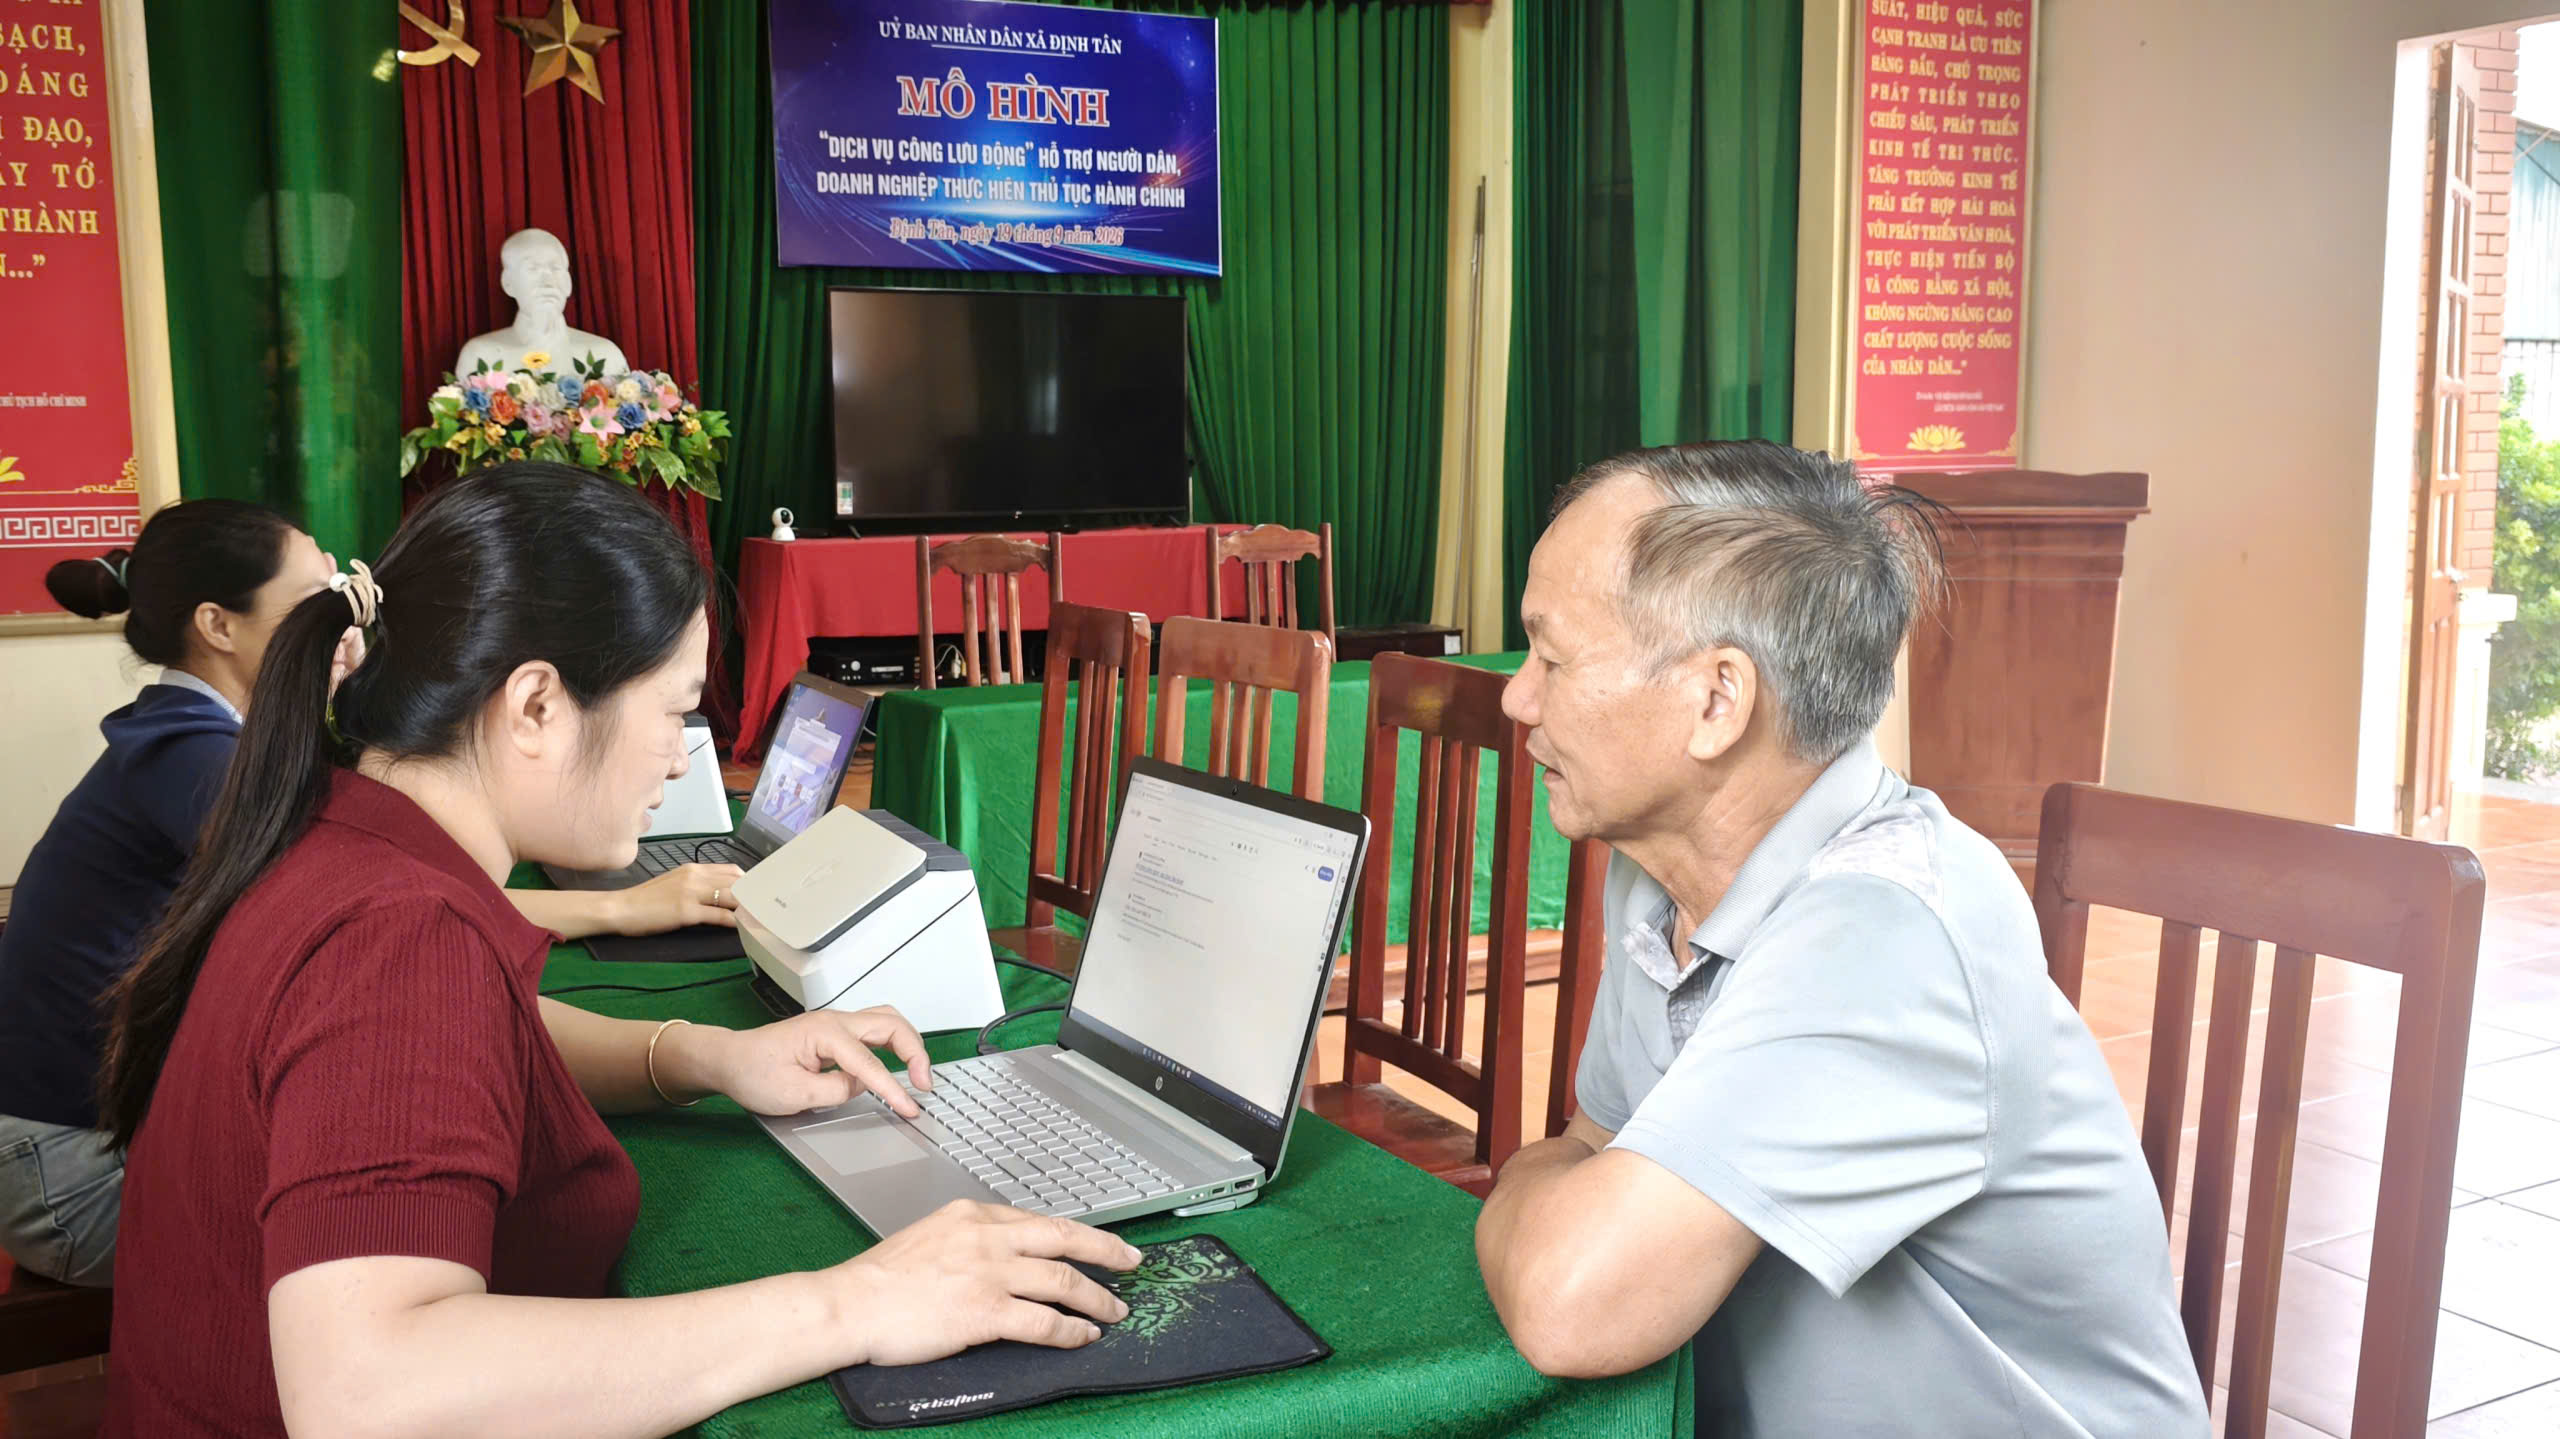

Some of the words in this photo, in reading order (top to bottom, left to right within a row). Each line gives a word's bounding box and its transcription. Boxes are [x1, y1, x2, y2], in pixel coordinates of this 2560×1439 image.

[1916, 2, 1949, 24] HIỆU
[1956, 4, 1988, 28] QUẢ,
[0, 22, 86, 56] ẠCH,
[879, 16, 901, 38] UỶ
[906, 23, 938, 41] BAN
[942, 23, 986, 45] NHÂN
[990, 26, 1022, 46] DÂN
[1026, 29, 1046, 49] XÃ
[1050, 35, 1089, 55] ĐỊNH
[1092, 34, 1122, 54] TÂN
[1872, 26, 1904, 48] CẠNH
[1906, 30, 1948, 50] TRANH
[1951, 32, 1966, 52] LÀ
[1970, 36, 1988, 53] ƯU
[1992, 35, 2022, 55] TIÊN
[1870, 52, 1904, 74] HÀNG
[1978, 64, 2022, 85] TRỌNG
[896, 66, 976, 119] MÔ
[986, 72, 1110, 127] HÌNH
[1870, 81, 1910, 102] PHÁT
[1918, 82, 1968, 106] TRIỂN
[1976, 92, 2021, 110] THEO
[22, 116, 93, 149] ĐẠO,
[1943, 114, 1976, 134] PHÁT
[872, 139, 894, 165] VỤ
[899, 136, 944, 163] CÔNG
[948, 141, 978, 165] LƯU
[1038, 142, 1060, 169] HỖ
[1064, 148, 1093, 175] TRỢ
[1097, 148, 1142, 174] NGƯỜI
[1146, 150, 1182, 177] DÂN,
[1868, 138, 1904, 158] KINH
[1912, 138, 1930, 159] TẾ
[1938, 144, 1964, 160] TRI
[52, 156, 96, 189] TỚ
[1906, 165, 1956, 188] TRƯỞNG
[1962, 172, 1993, 189] KINH
[2001, 169, 2018, 190] TẾ
[816, 172, 874, 196] DOANH
[878, 172, 938, 202] NGHIỆP
[942, 178, 983, 204] THỰC
[1029, 176, 1058, 203] THỦ
[1062, 184, 1091, 208] TỤC
[1095, 181, 1136, 206] HÀNH
[1140, 182, 1185, 208] CHÍNH
[1868, 190, 1895, 212] PHẢI
[1901, 191, 1926, 213] KẾT
[1930, 196, 1956, 218] HỢP
[1962, 196, 1984, 216] HÀI
[890, 217, 924, 244] Định
[927, 218, 958, 244] Tân,
[960, 221, 994, 246] ngày
[995, 223, 1013, 243] 19
[1014, 223, 1052, 247] tháng
[1054, 225, 1064, 244] 9
[1064, 226, 1095, 244] năm
[1094, 227, 1124, 246] 2026
[1866, 218, 1887, 239] VỚI
[1888, 220, 1920, 240] PHÁT
[1866, 249, 1902, 270] THỰC
[1910, 248, 1945, 272] HIỆN
[1952, 248, 1986, 270] TIẾN
[1994, 250, 2015, 274] BỘ
[1865, 273, 1880, 294] VÀ
[1886, 274, 1920, 294] CÔNG
[1864, 300, 1905, 322] KHÔNG
[1906, 302, 1949, 322] NGỪNG
[1951, 302, 1985, 322] NÂNG
[1986, 306, 2013, 324] CAO
[1864, 326, 1894, 348] CHẤT
[1897, 330, 1938, 352] LƯỢNG
[1942, 330, 1975, 352] CUỘC
[1977, 328, 2012, 349] SỐNG
[1863, 354, 1886, 376] CỦA
[1890, 355, 1924, 376] NHÂN
